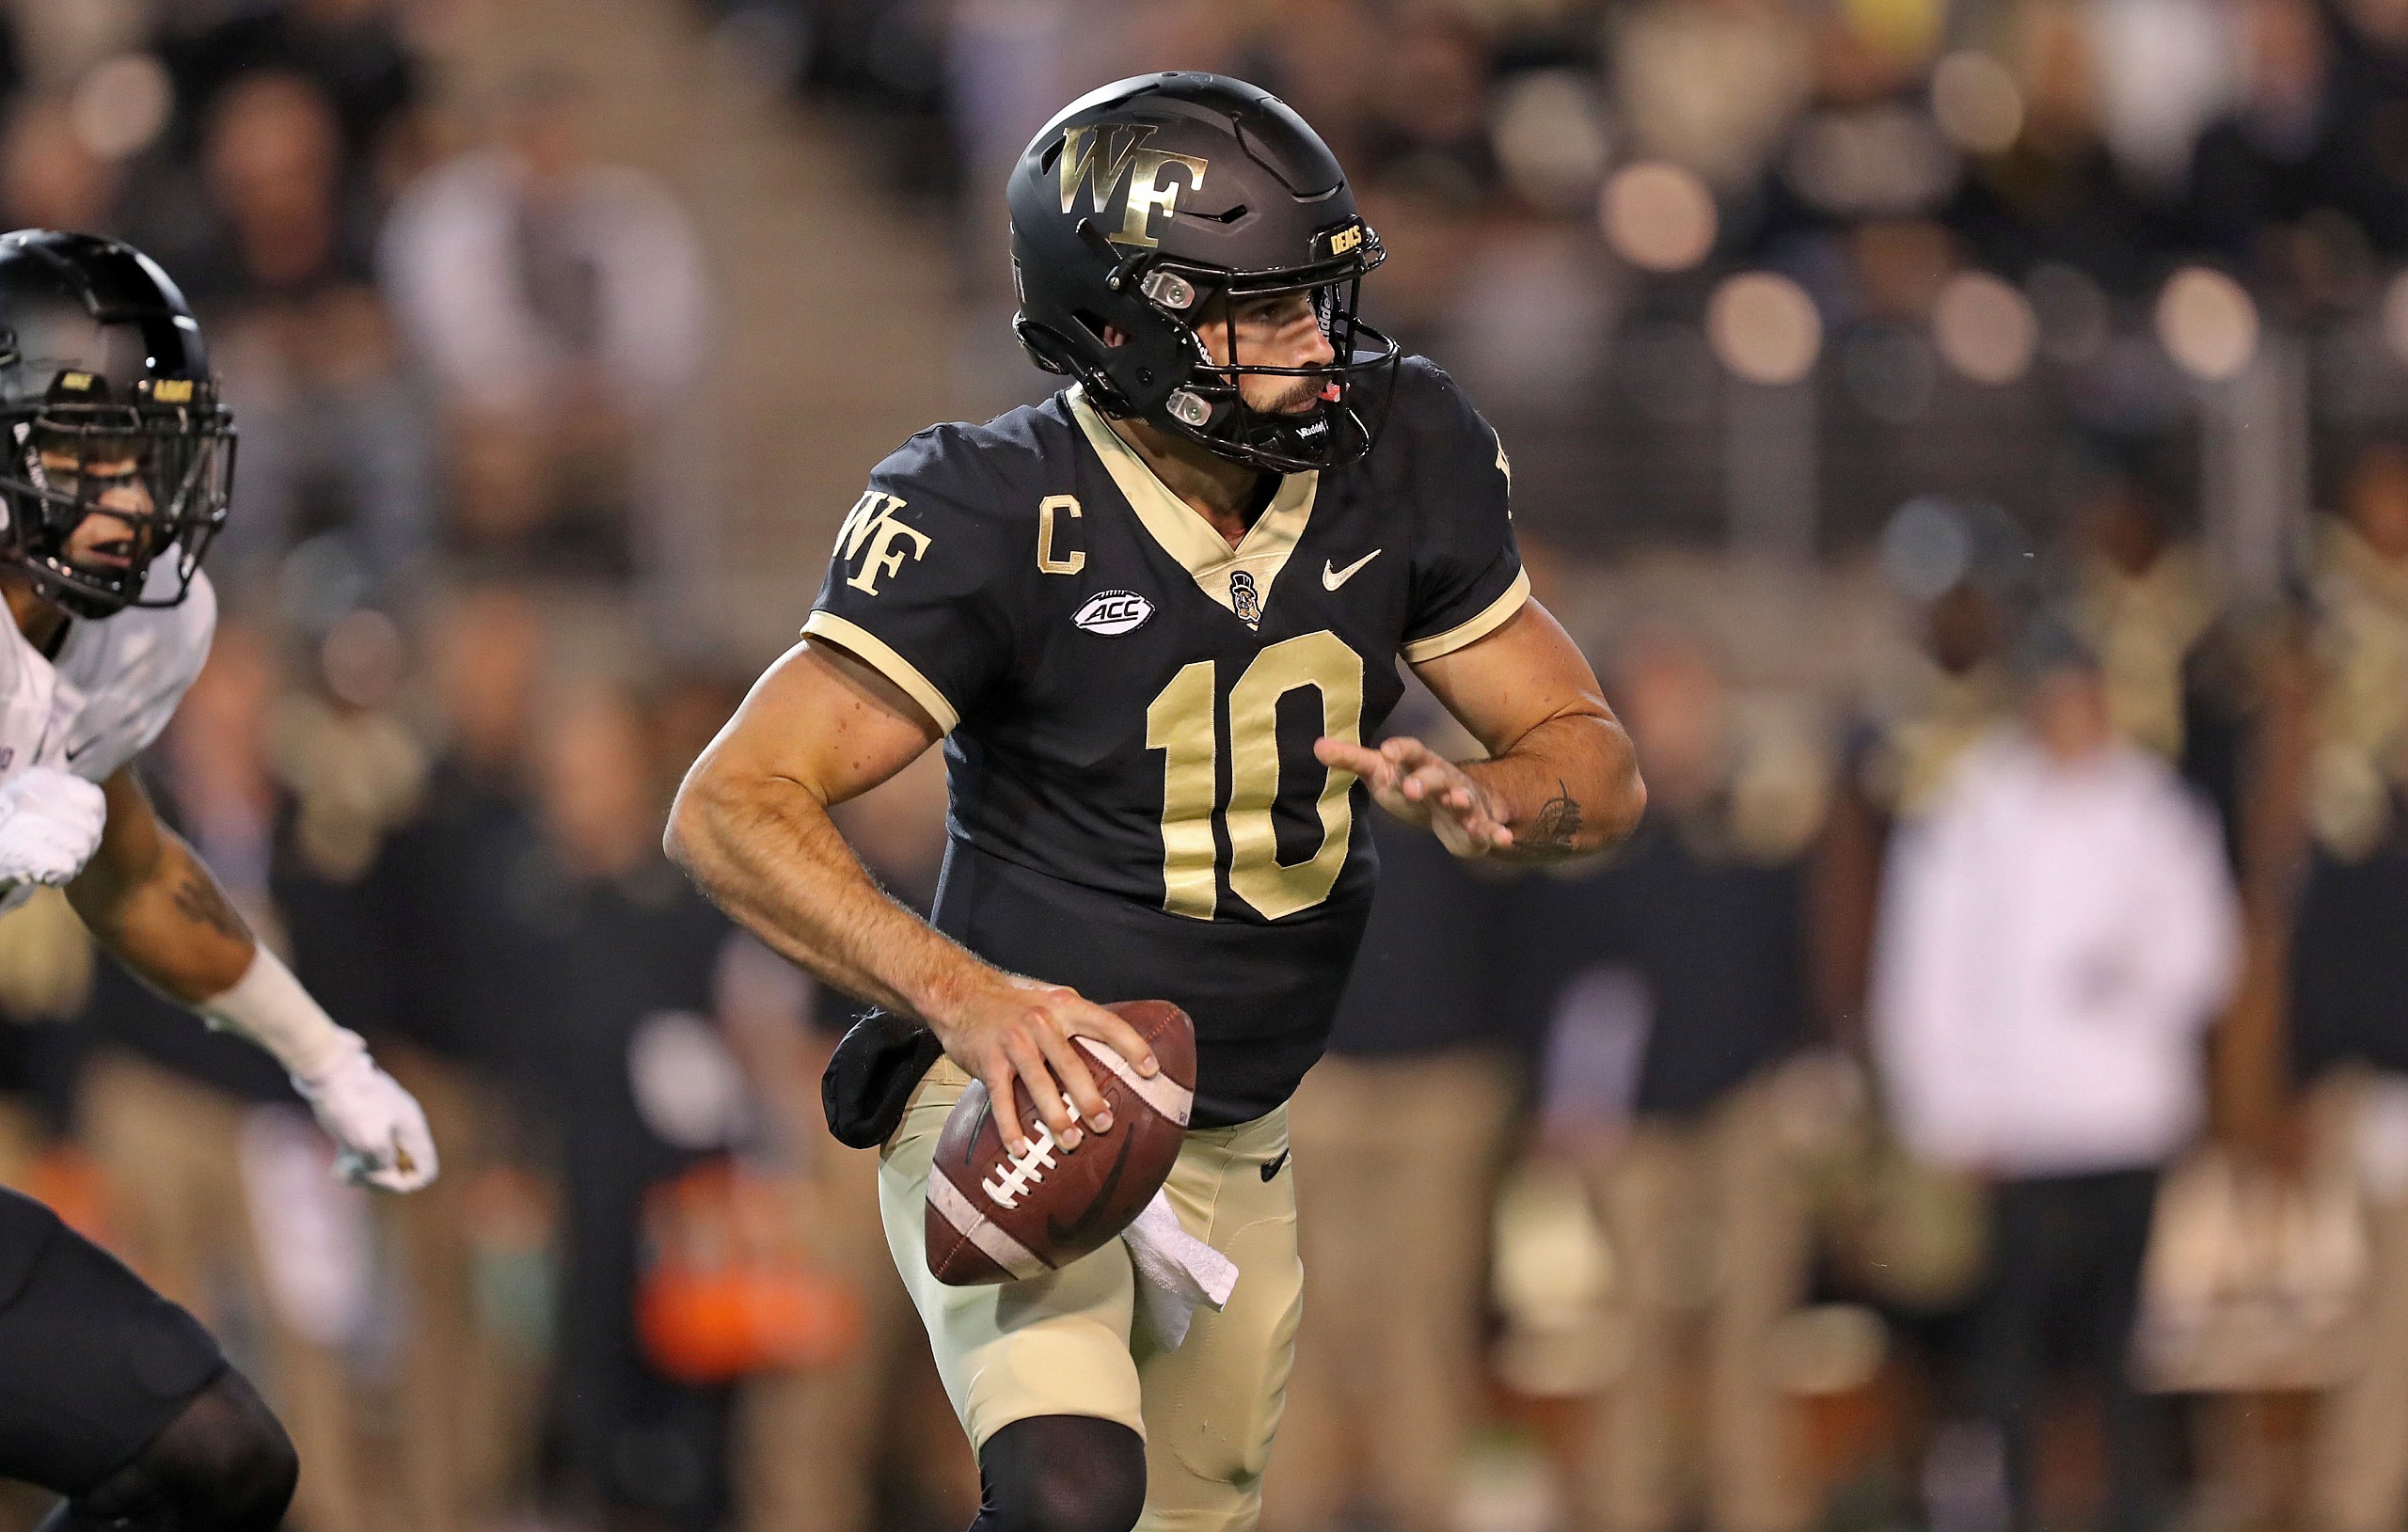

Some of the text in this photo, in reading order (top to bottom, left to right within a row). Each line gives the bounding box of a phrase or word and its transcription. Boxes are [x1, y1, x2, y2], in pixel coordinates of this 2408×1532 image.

[1058, 123, 1209, 248] WF
[1330, 225, 1363, 256] DEACS
[832, 490, 933, 597] WF
[1037, 494, 1086, 576] C
[1084, 598, 1142, 623] ACC
[1145, 629, 1364, 921] 10
